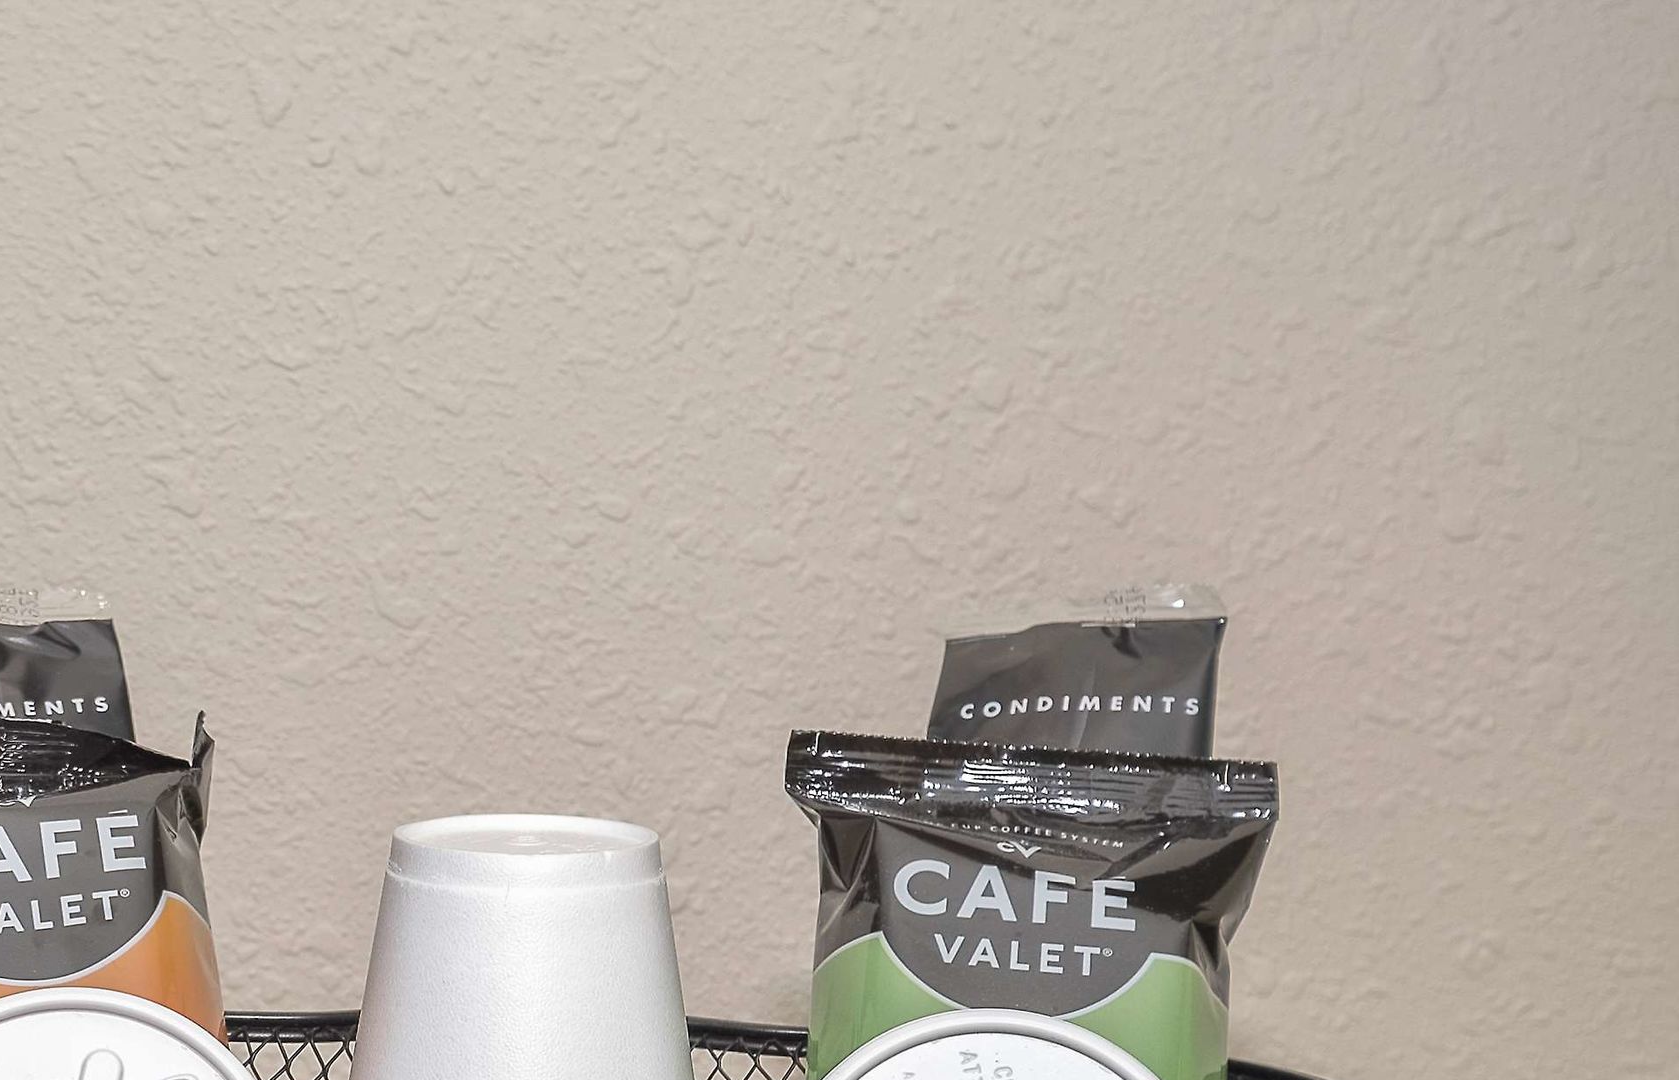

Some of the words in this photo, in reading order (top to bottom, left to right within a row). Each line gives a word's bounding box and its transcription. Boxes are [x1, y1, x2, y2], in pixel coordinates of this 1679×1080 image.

[960, 694, 1200, 720] CONDIMENTS
[989, 825, 1053, 838] COFFEE
[1060, 831, 1124, 849] SYSTEM
